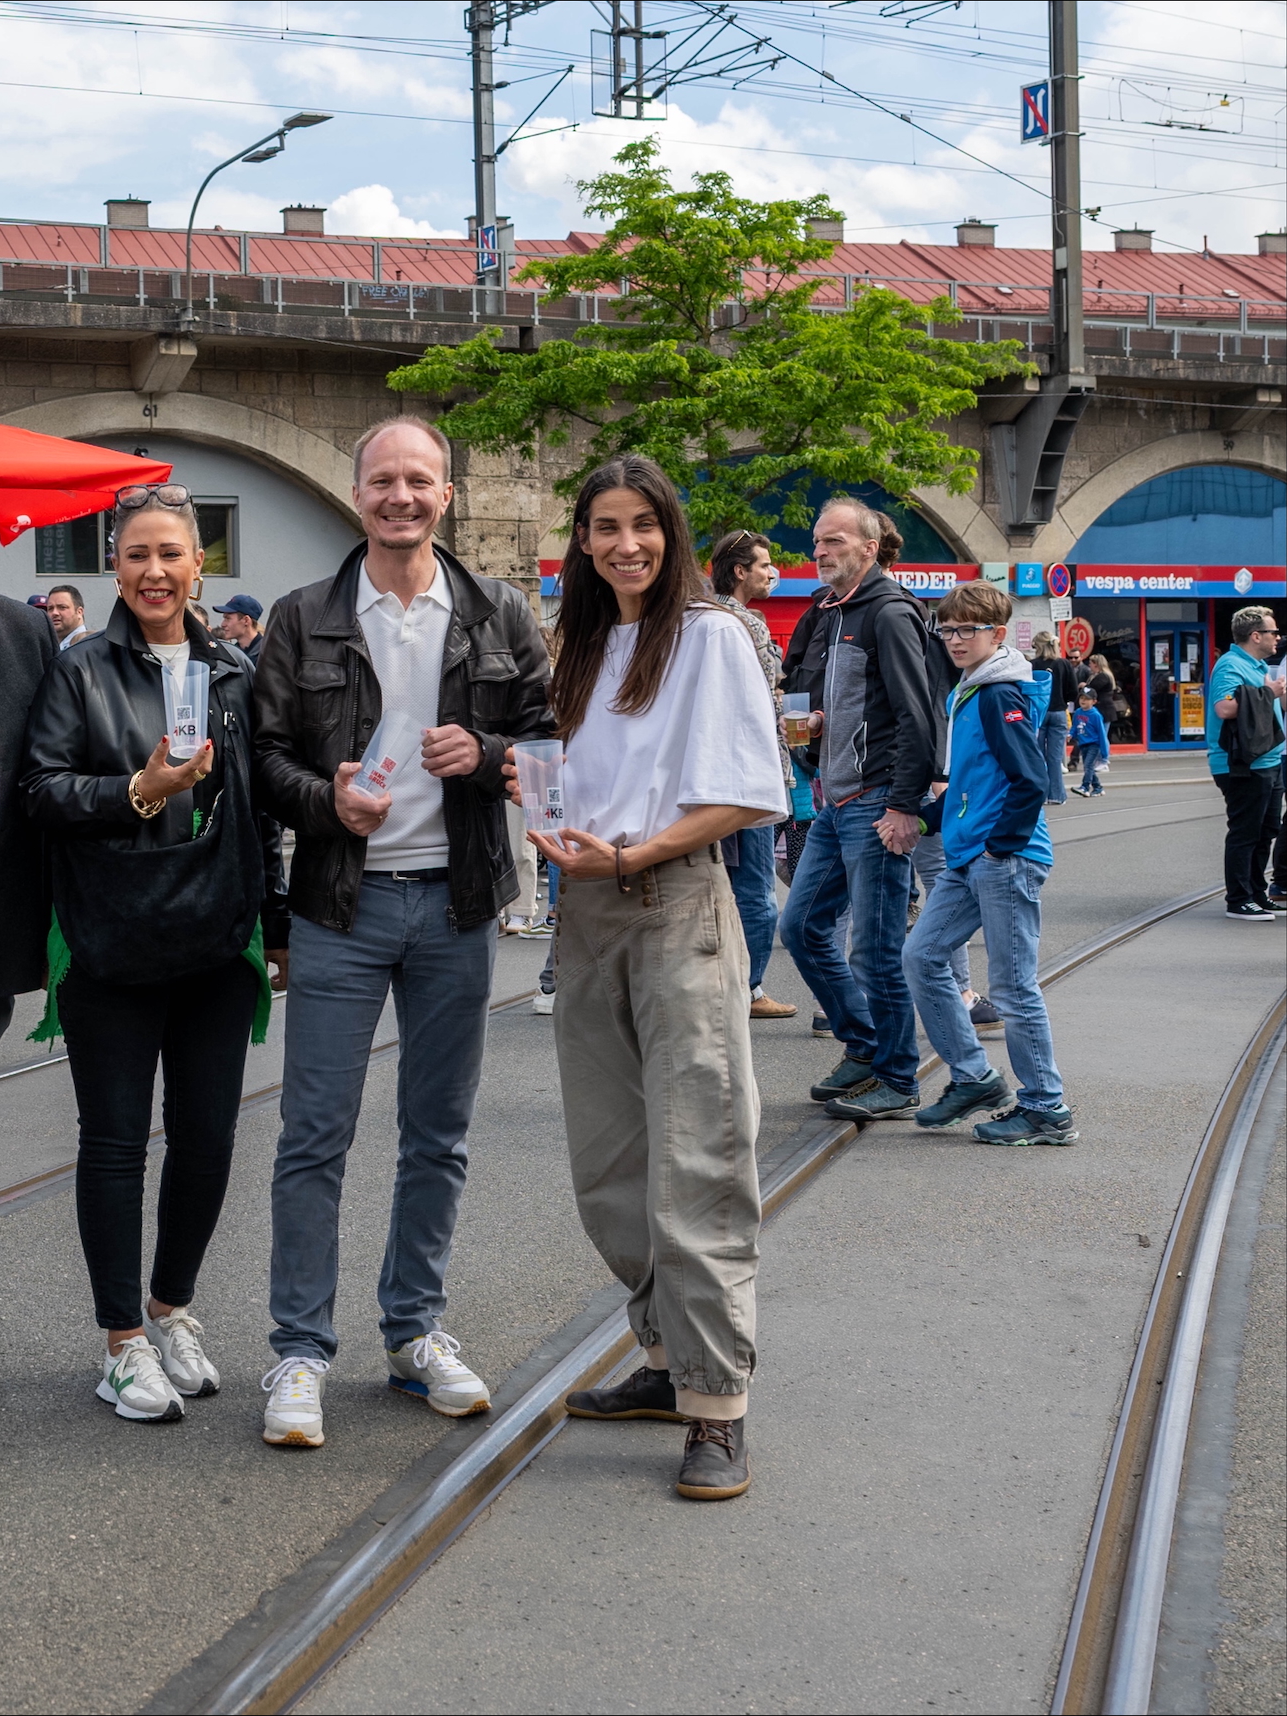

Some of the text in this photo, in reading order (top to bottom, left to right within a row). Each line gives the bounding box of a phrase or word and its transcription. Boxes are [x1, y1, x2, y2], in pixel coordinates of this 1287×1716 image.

[142, 403, 158, 418] 61
[1085, 573, 1193, 593] vespa center
[1069, 629, 1086, 644] 50
